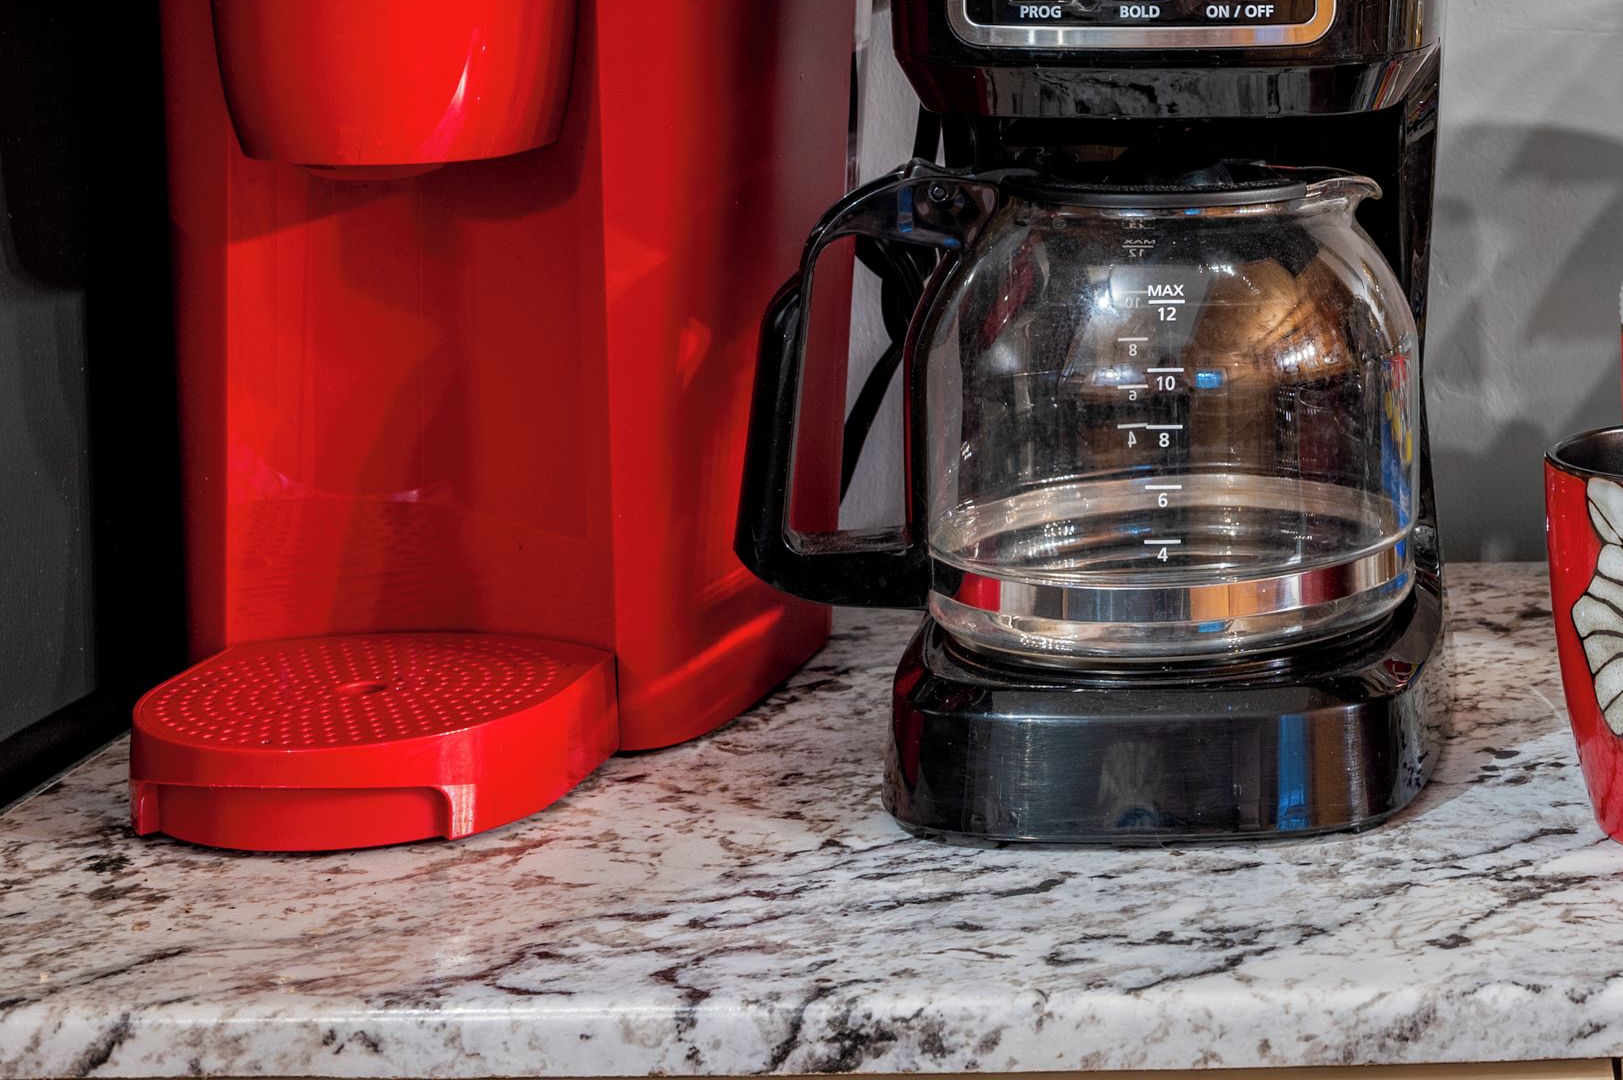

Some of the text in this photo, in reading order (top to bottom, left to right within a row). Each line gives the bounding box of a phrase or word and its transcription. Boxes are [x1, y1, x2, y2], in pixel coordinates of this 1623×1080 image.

[1019, 5, 1062, 19] PROG
[1119, 5, 1161, 19] BOLD
[1206, 5, 1274, 19] ON / OFF
[1147, 284, 1184, 297] MAX
[1157, 307, 1177, 321] 12
[1156, 376, 1176, 391] 10
[1158, 433, 1170, 448] 8
[1157, 493, 1169, 508] 6
[1156, 547, 1169, 562] 4
